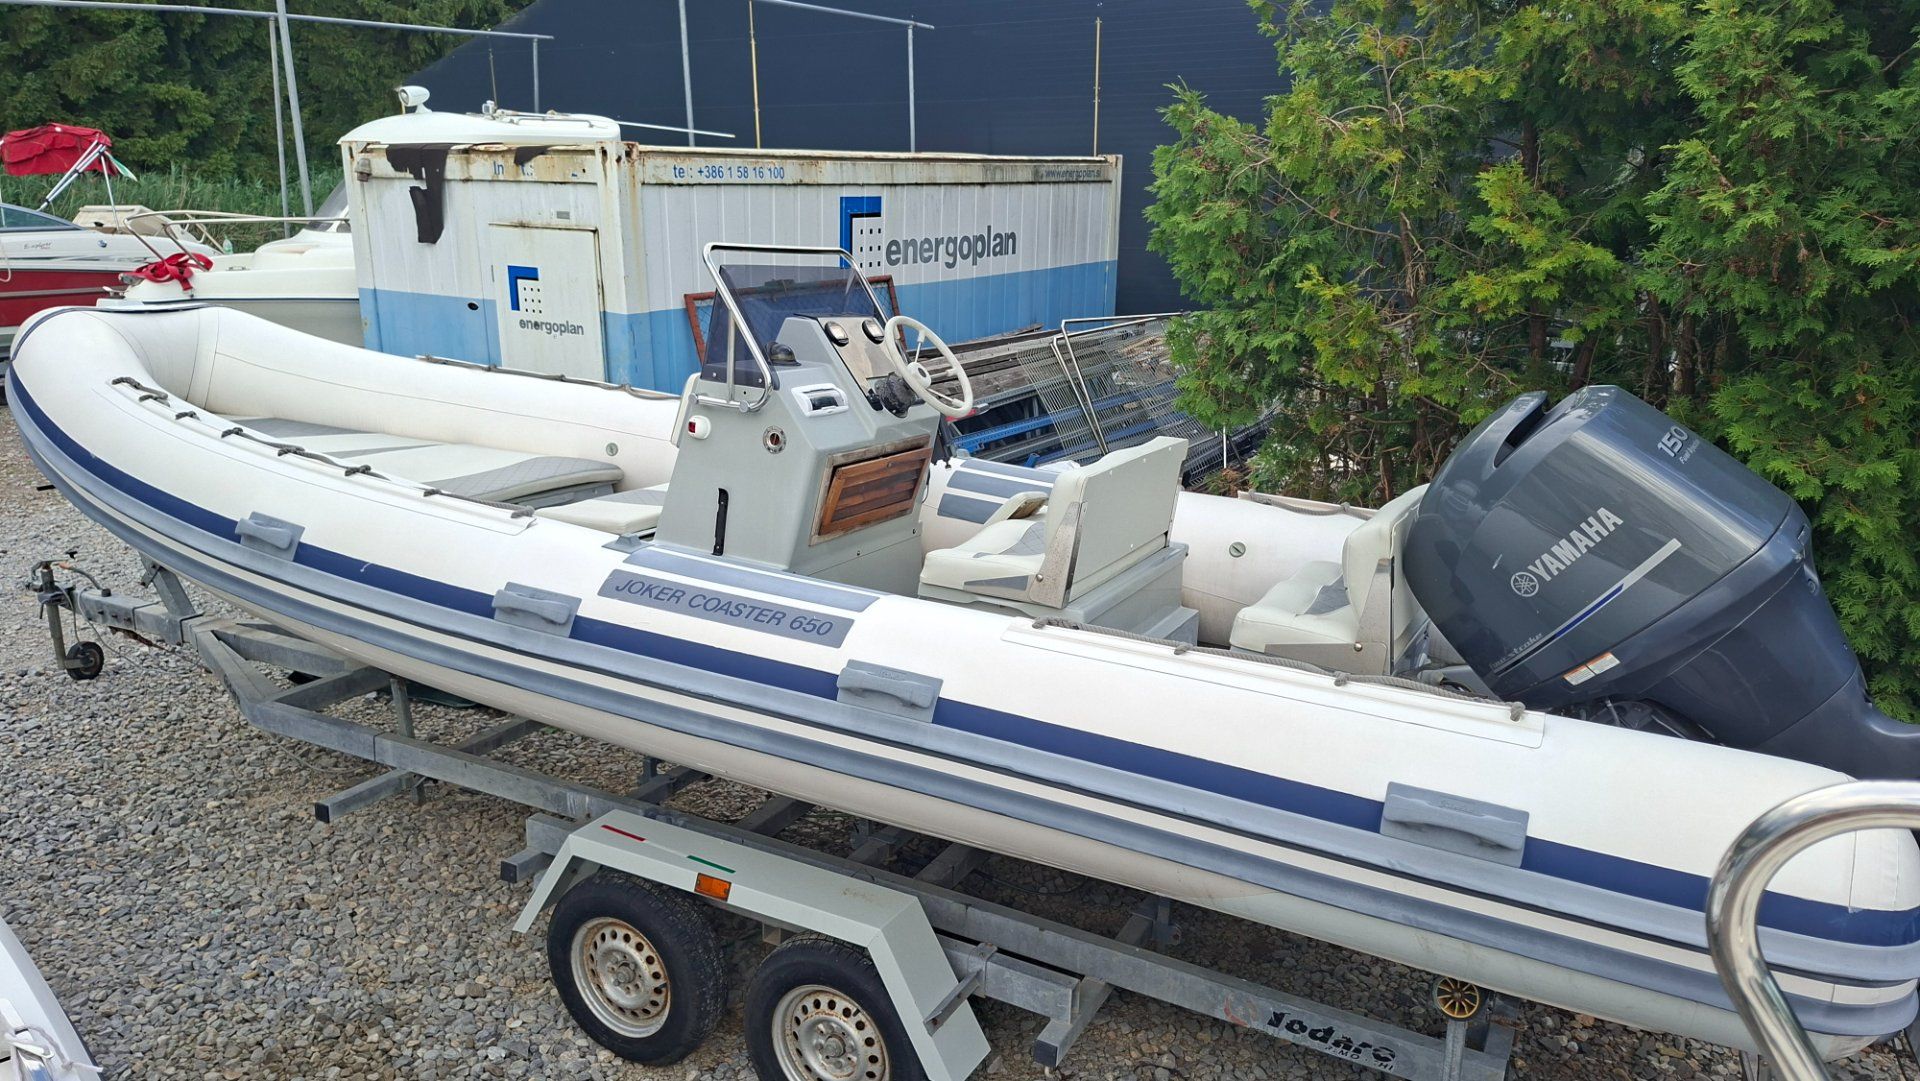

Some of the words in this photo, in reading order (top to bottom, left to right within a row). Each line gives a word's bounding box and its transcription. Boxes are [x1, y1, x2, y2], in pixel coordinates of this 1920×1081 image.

[697, 165, 724, 179] +386
[727, 166, 733, 178] 1
[736, 166, 749, 179] 58
[752, 167, 764, 179] 16
[768, 167, 785, 180] 100
[885, 225, 1017, 269] energoplan
[519, 319, 584, 336] energoplan
[1657, 425, 1688, 457] 150
[1527, 506, 1624, 581] YAMAHA
[615, 579, 686, 605] JOKER
[688, 593, 787, 627] COASTER
[789, 614, 834, 637] 650
